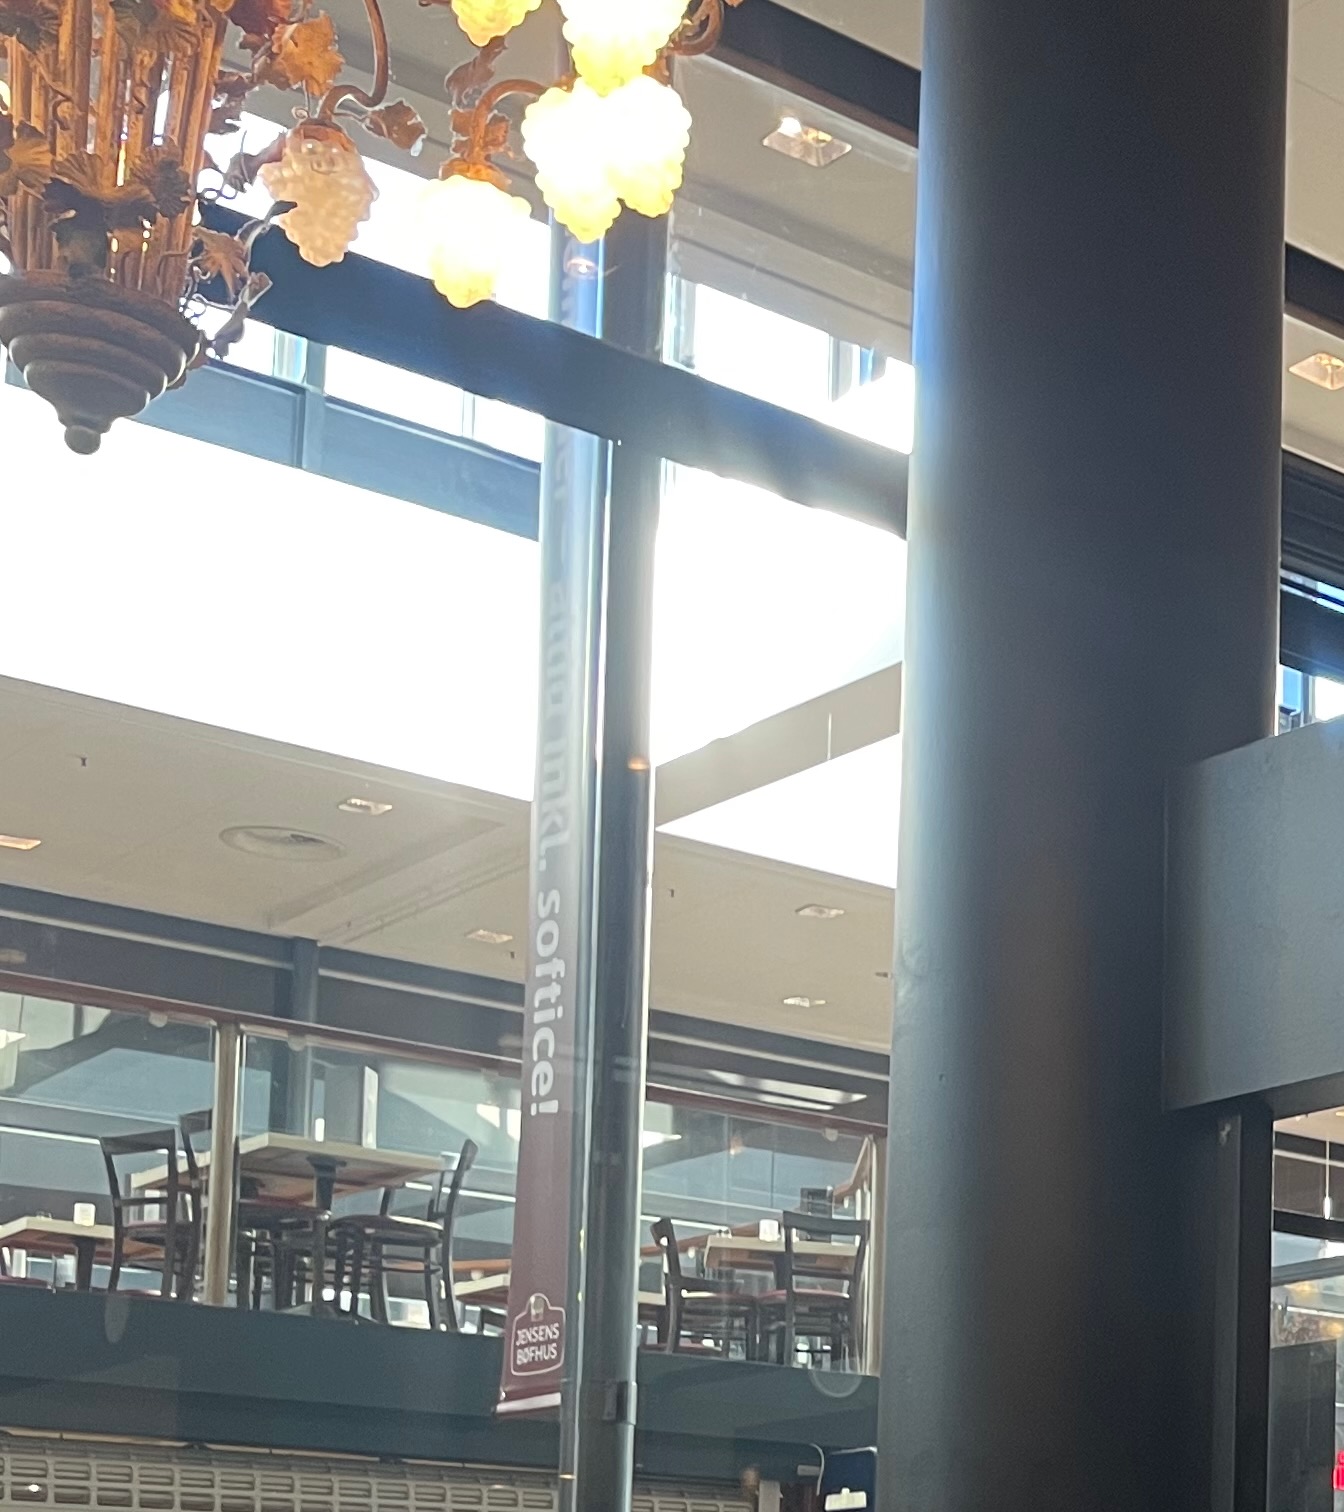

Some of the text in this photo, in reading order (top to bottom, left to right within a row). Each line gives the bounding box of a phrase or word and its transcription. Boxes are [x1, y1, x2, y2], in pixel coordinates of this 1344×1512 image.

[530, 888, 566, 1117] softice!
[515, 1321, 560, 1347] JENSENS
[515, 1342, 558, 1366] BØFHUS
